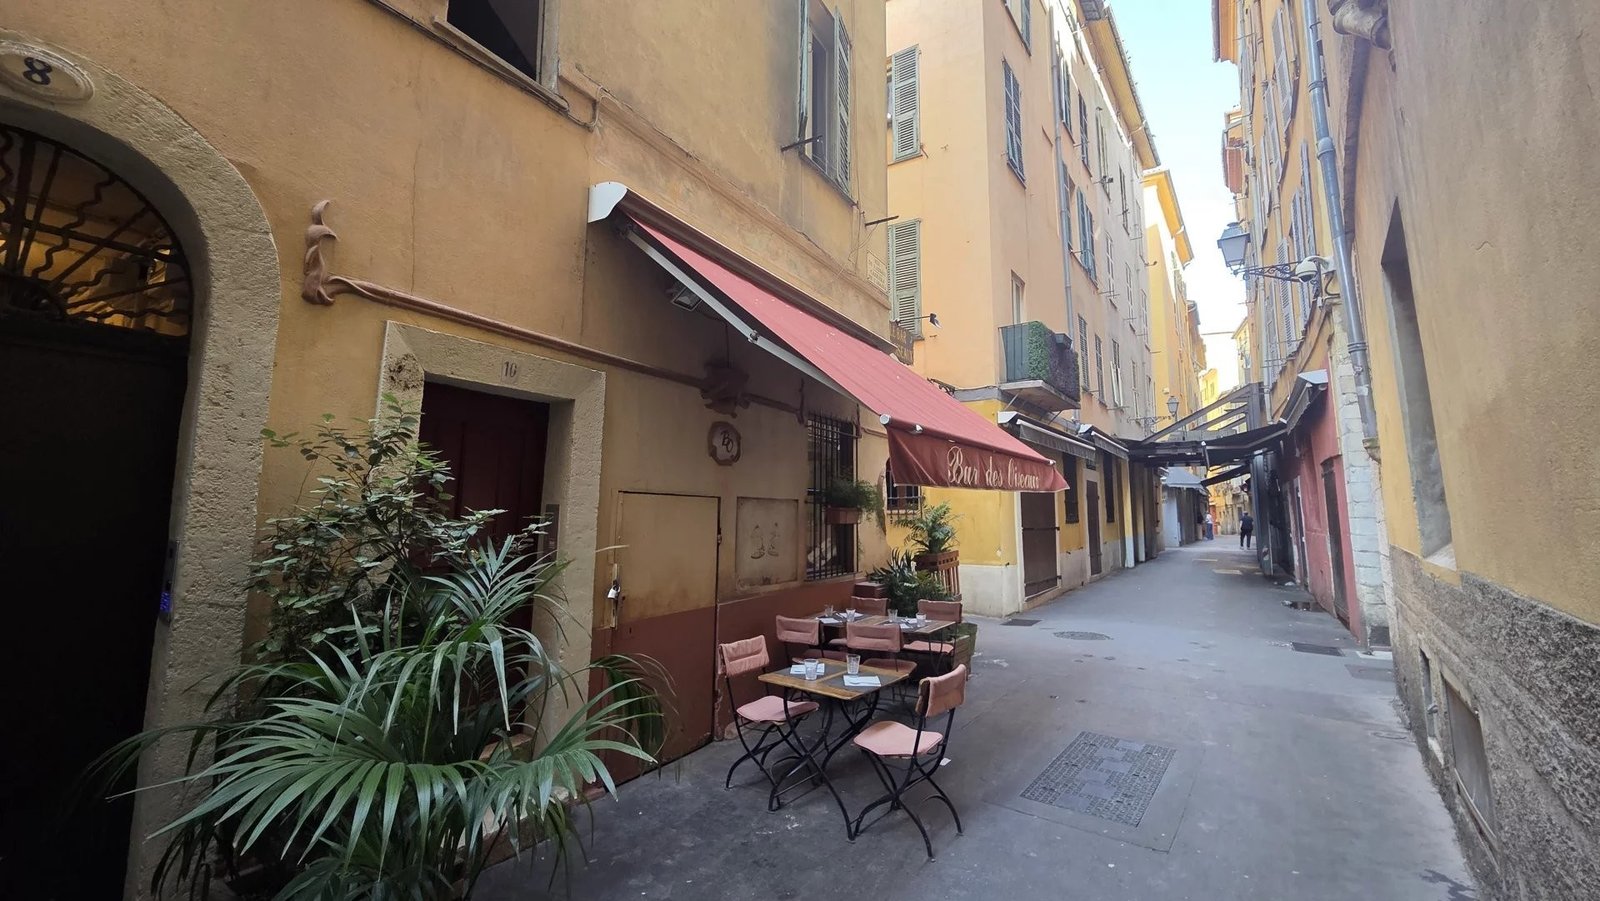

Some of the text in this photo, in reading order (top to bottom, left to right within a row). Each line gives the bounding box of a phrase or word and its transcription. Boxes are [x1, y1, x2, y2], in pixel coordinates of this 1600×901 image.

[23, 57, 52, 85] 8
[947, 446, 979, 484] Bar
[985, 456, 1003, 488] des
